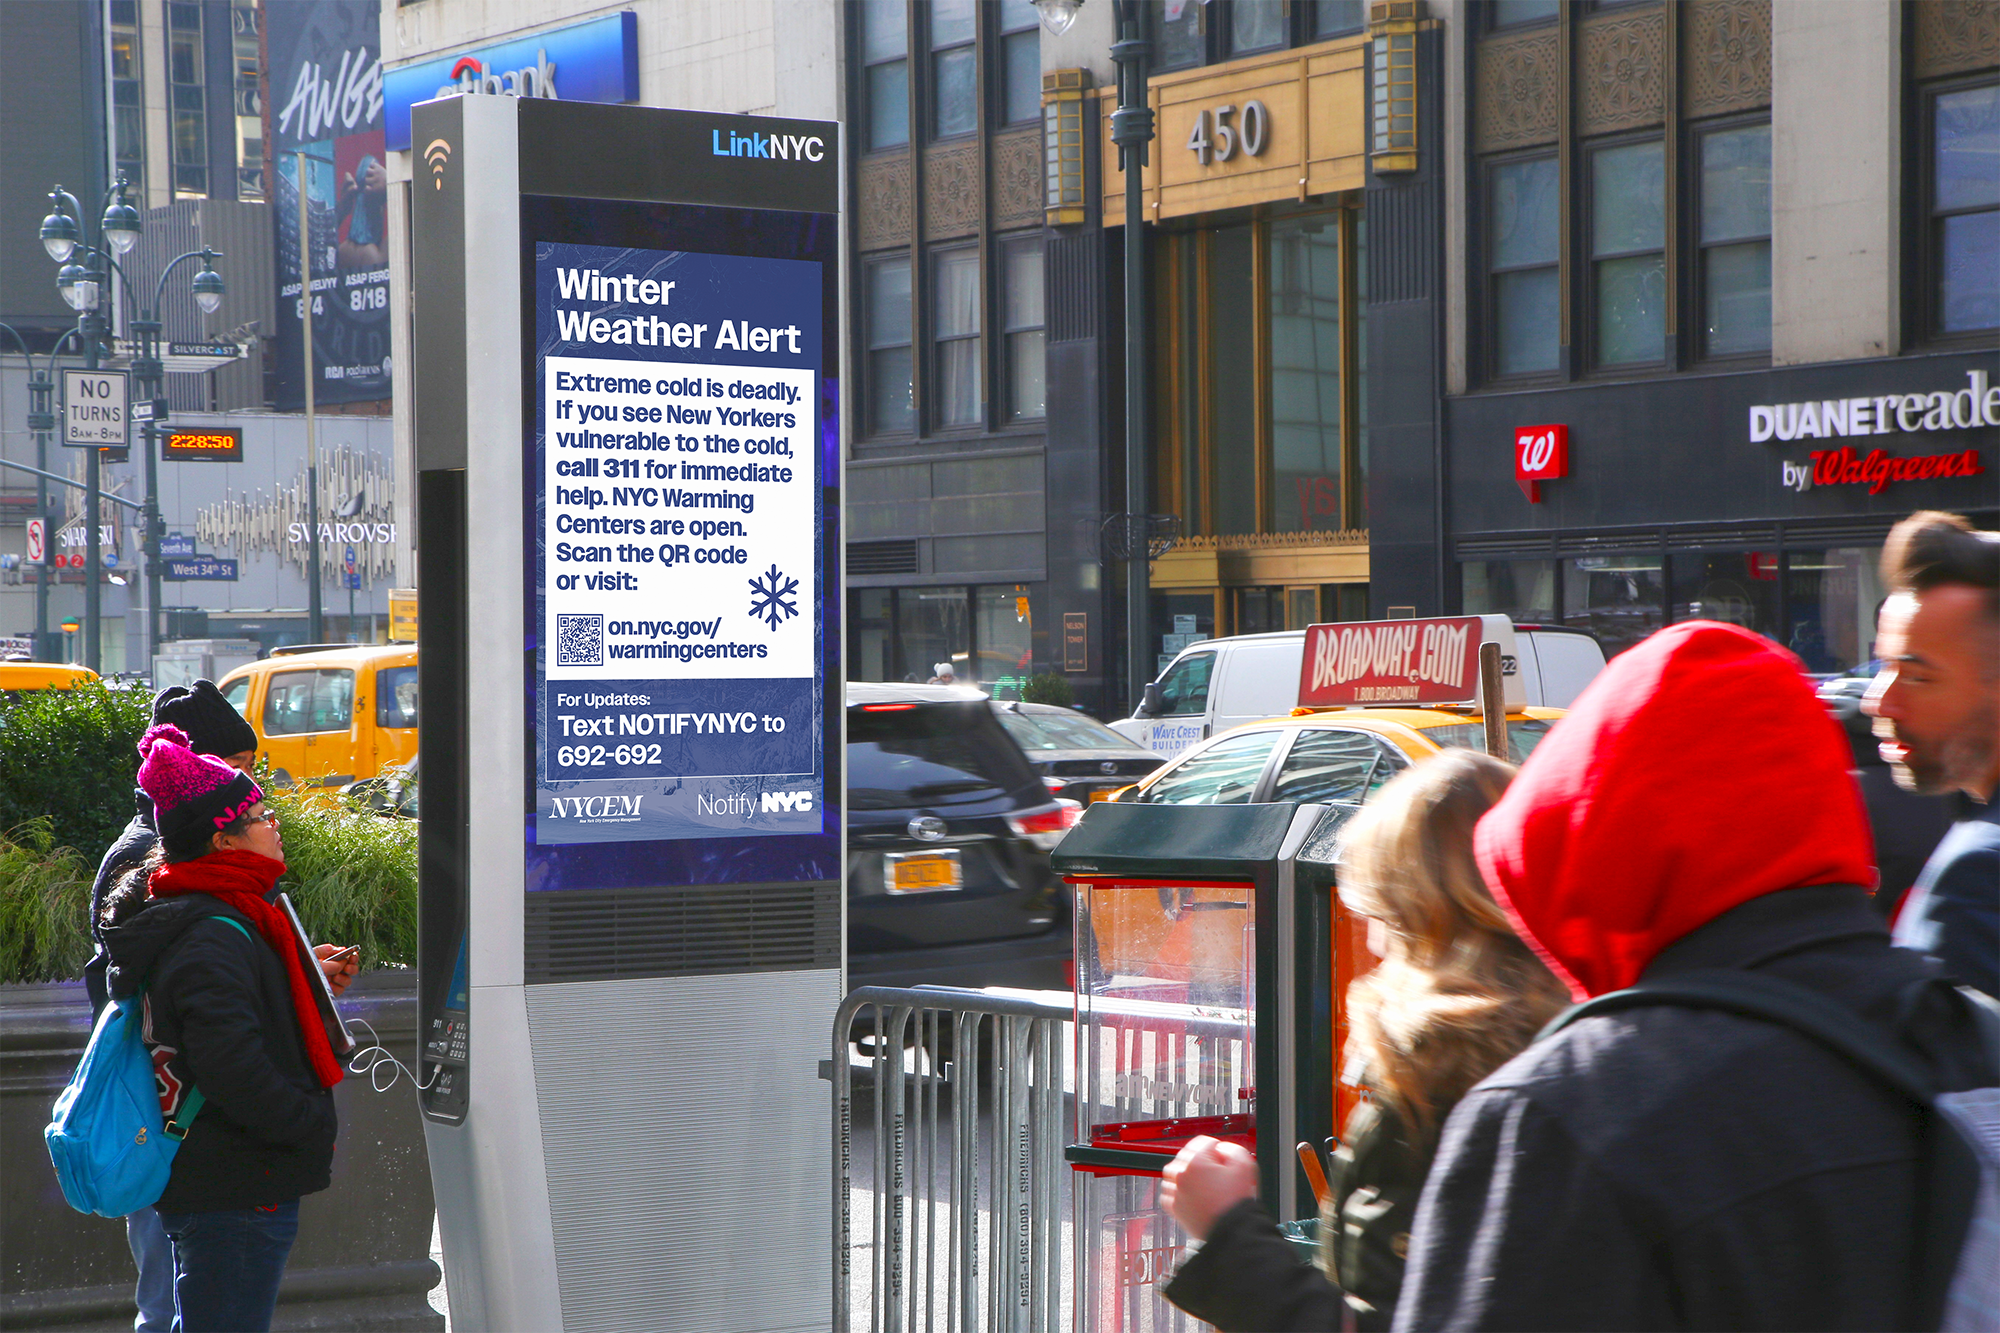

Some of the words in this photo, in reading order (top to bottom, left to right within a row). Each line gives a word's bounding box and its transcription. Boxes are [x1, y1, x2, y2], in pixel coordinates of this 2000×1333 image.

[435, 48, 558, 99] bank
[712, 129, 824, 162] LinkNYC
[1186, 100, 1269, 167] 450
[345, 273, 368, 286] ASAP
[556, 267, 676, 306] Winter
[350, 287, 387, 311] 8/18
[556, 309, 708, 349] Weather
[714, 319, 802, 354] Alert
[173, 344, 235, 355] SILVERCAST
[80, 380, 110, 399] NO
[556, 371, 652, 395] Extreme
[655, 377, 702, 397] cold
[706, 377, 724, 398] is
[727, 380, 802, 406] deadly.
[71, 405, 121, 422] TURNS
[556, 399, 573, 420] If
[576, 404, 618, 425] you
[622, 405, 663, 424] see
[666, 404, 712, 425] New
[715, 406, 796, 429] Yorkers
[169, 433, 235, 449] 2:28:50
[556, 429, 671, 452] vulnerable
[674, 433, 699, 452] to
[703, 434, 740, 454] the
[743, 436, 794, 460] cold,
[1518, 430, 1555, 472] W
[556, 457, 599, 478] call
[603, 458, 640, 479] 311
[643, 459, 677, 480] for
[681, 460, 793, 483] immediate
[1783, 461, 1811, 492] by
[1809, 446, 1986, 495] Walgreens
[556, 485, 609, 511] help.
[612, 486, 659, 508] NYC
[661, 488, 754, 514] Warming
[60, 524, 115, 548] SWARSKI
[556, 513, 646, 535] Centers
[649, 519, 685, 536] are
[688, 520, 748, 541] open.
[556, 542, 612, 563] Scan
[616, 543, 655, 563] the
[658, 543, 690, 568] QR
[693, 545, 748, 565] code
[173, 563, 199, 576] West
[201, 563, 220, 576] 34th
[221, 564, 232, 576] St
[556, 574, 580, 591] or
[584, 570, 638, 591] visit:
[608, 616, 723, 640] on.nyc.gov/
[608, 640, 768, 663] warmingcenters
[1311, 623, 1471, 693] BROADWAY.COM
[557, 693, 582, 707] For
[584, 692, 651, 709] Updates:
[1354, 685, 1421, 702] 1.800.BROADWAY
[557, 714, 615, 737] Text
[619, 711, 757, 736] NOTIFYNYC
[761, 714, 786, 733] to
[557, 743, 662, 767] 692-692
[548, 794, 644, 818] NYCEM
[697, 793, 758, 819] Notify
[761, 790, 813, 813] NYC
[432, 1019, 443, 1029] 911
